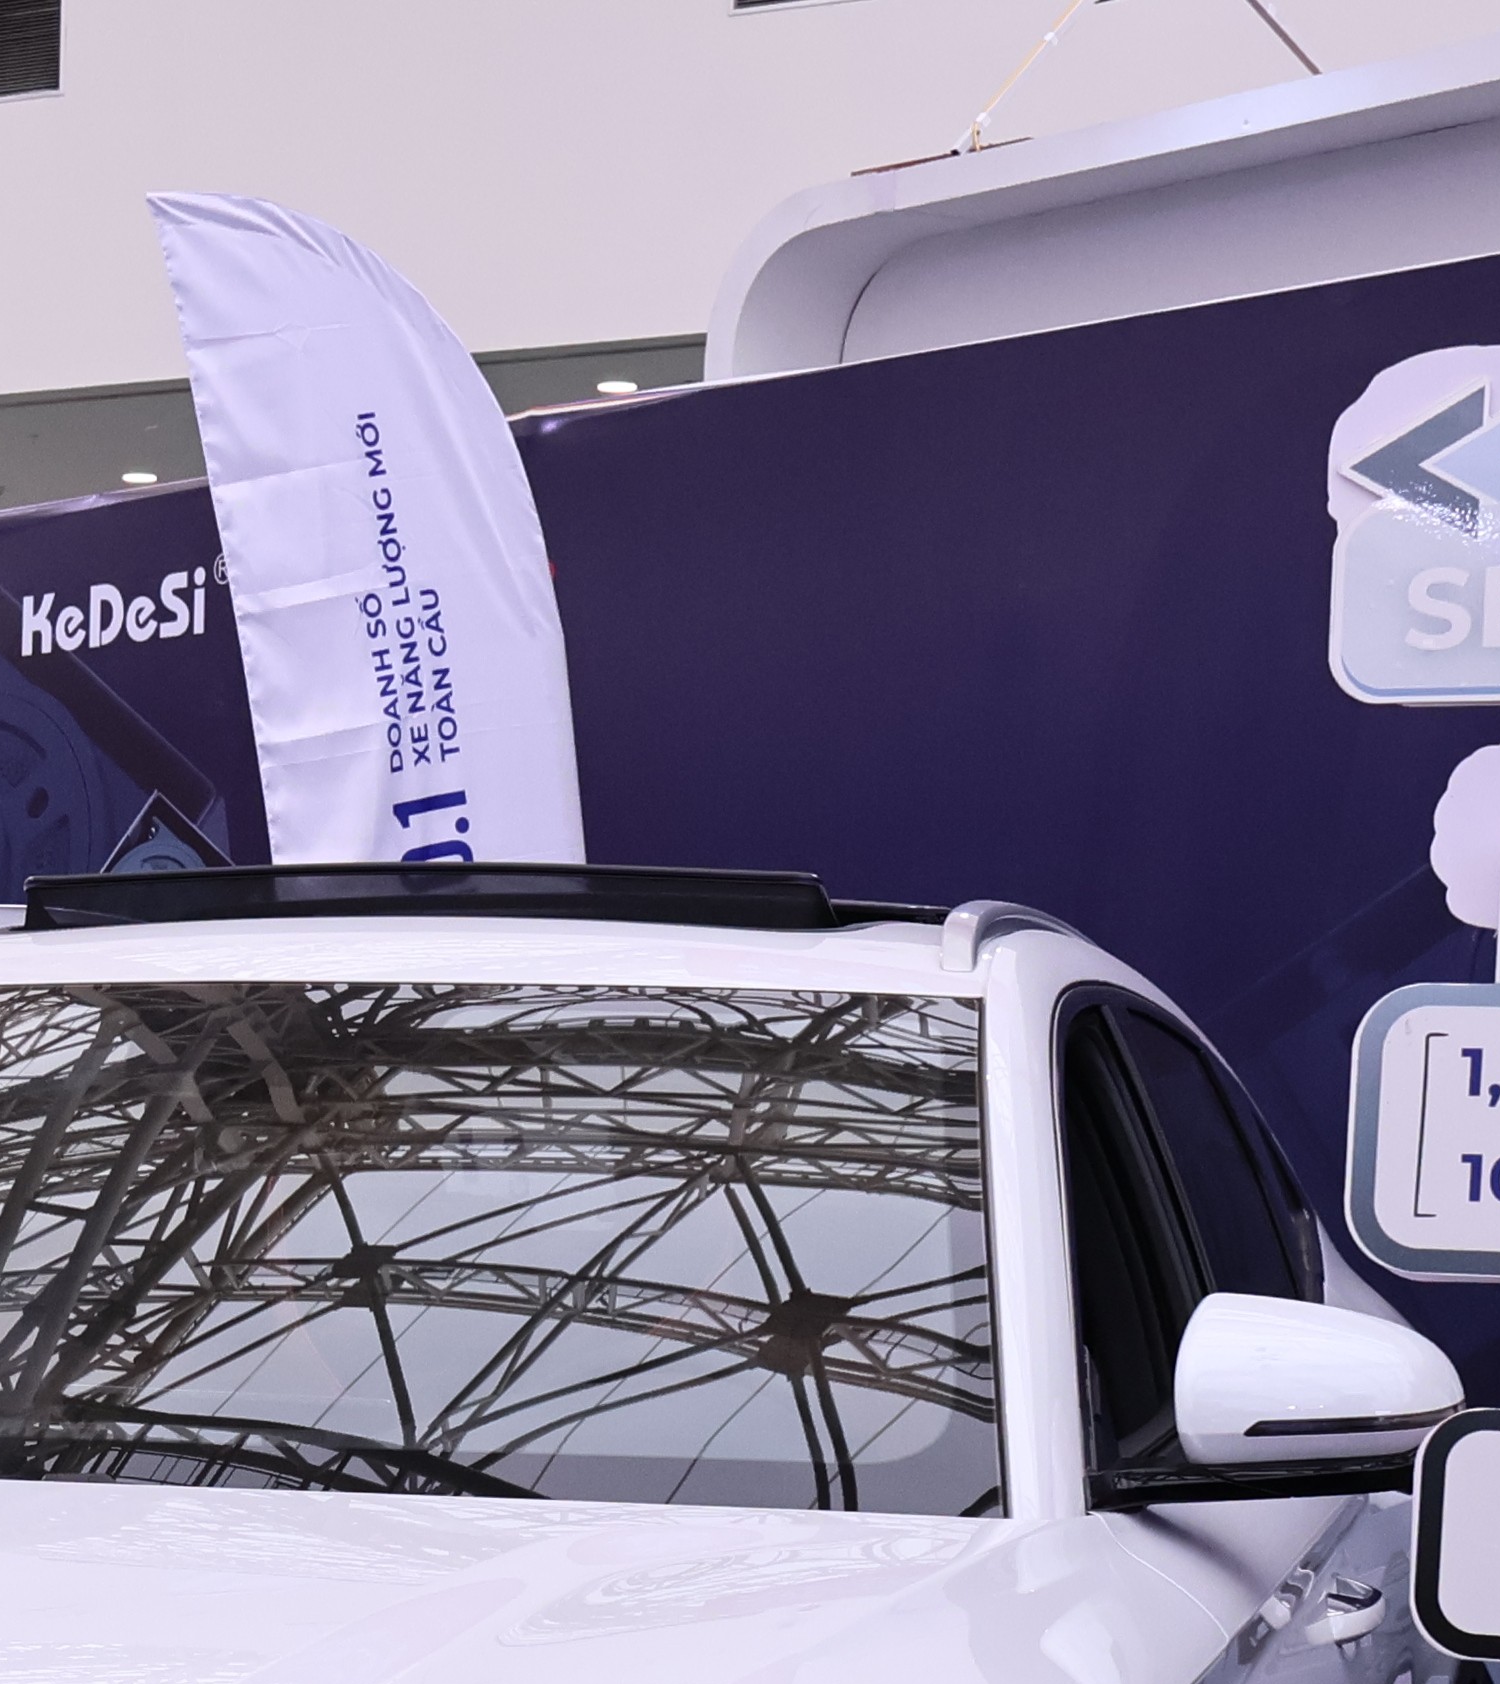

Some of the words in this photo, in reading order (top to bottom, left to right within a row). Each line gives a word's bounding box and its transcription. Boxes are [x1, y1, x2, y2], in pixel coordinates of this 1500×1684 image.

[356, 411, 387, 477] MỚI
[373, 486, 411, 606] LƯỢNG
[22, 566, 205, 657] KeDeSi
[395, 618, 425, 714] NĂNG
[412, 724, 431, 765] XE
